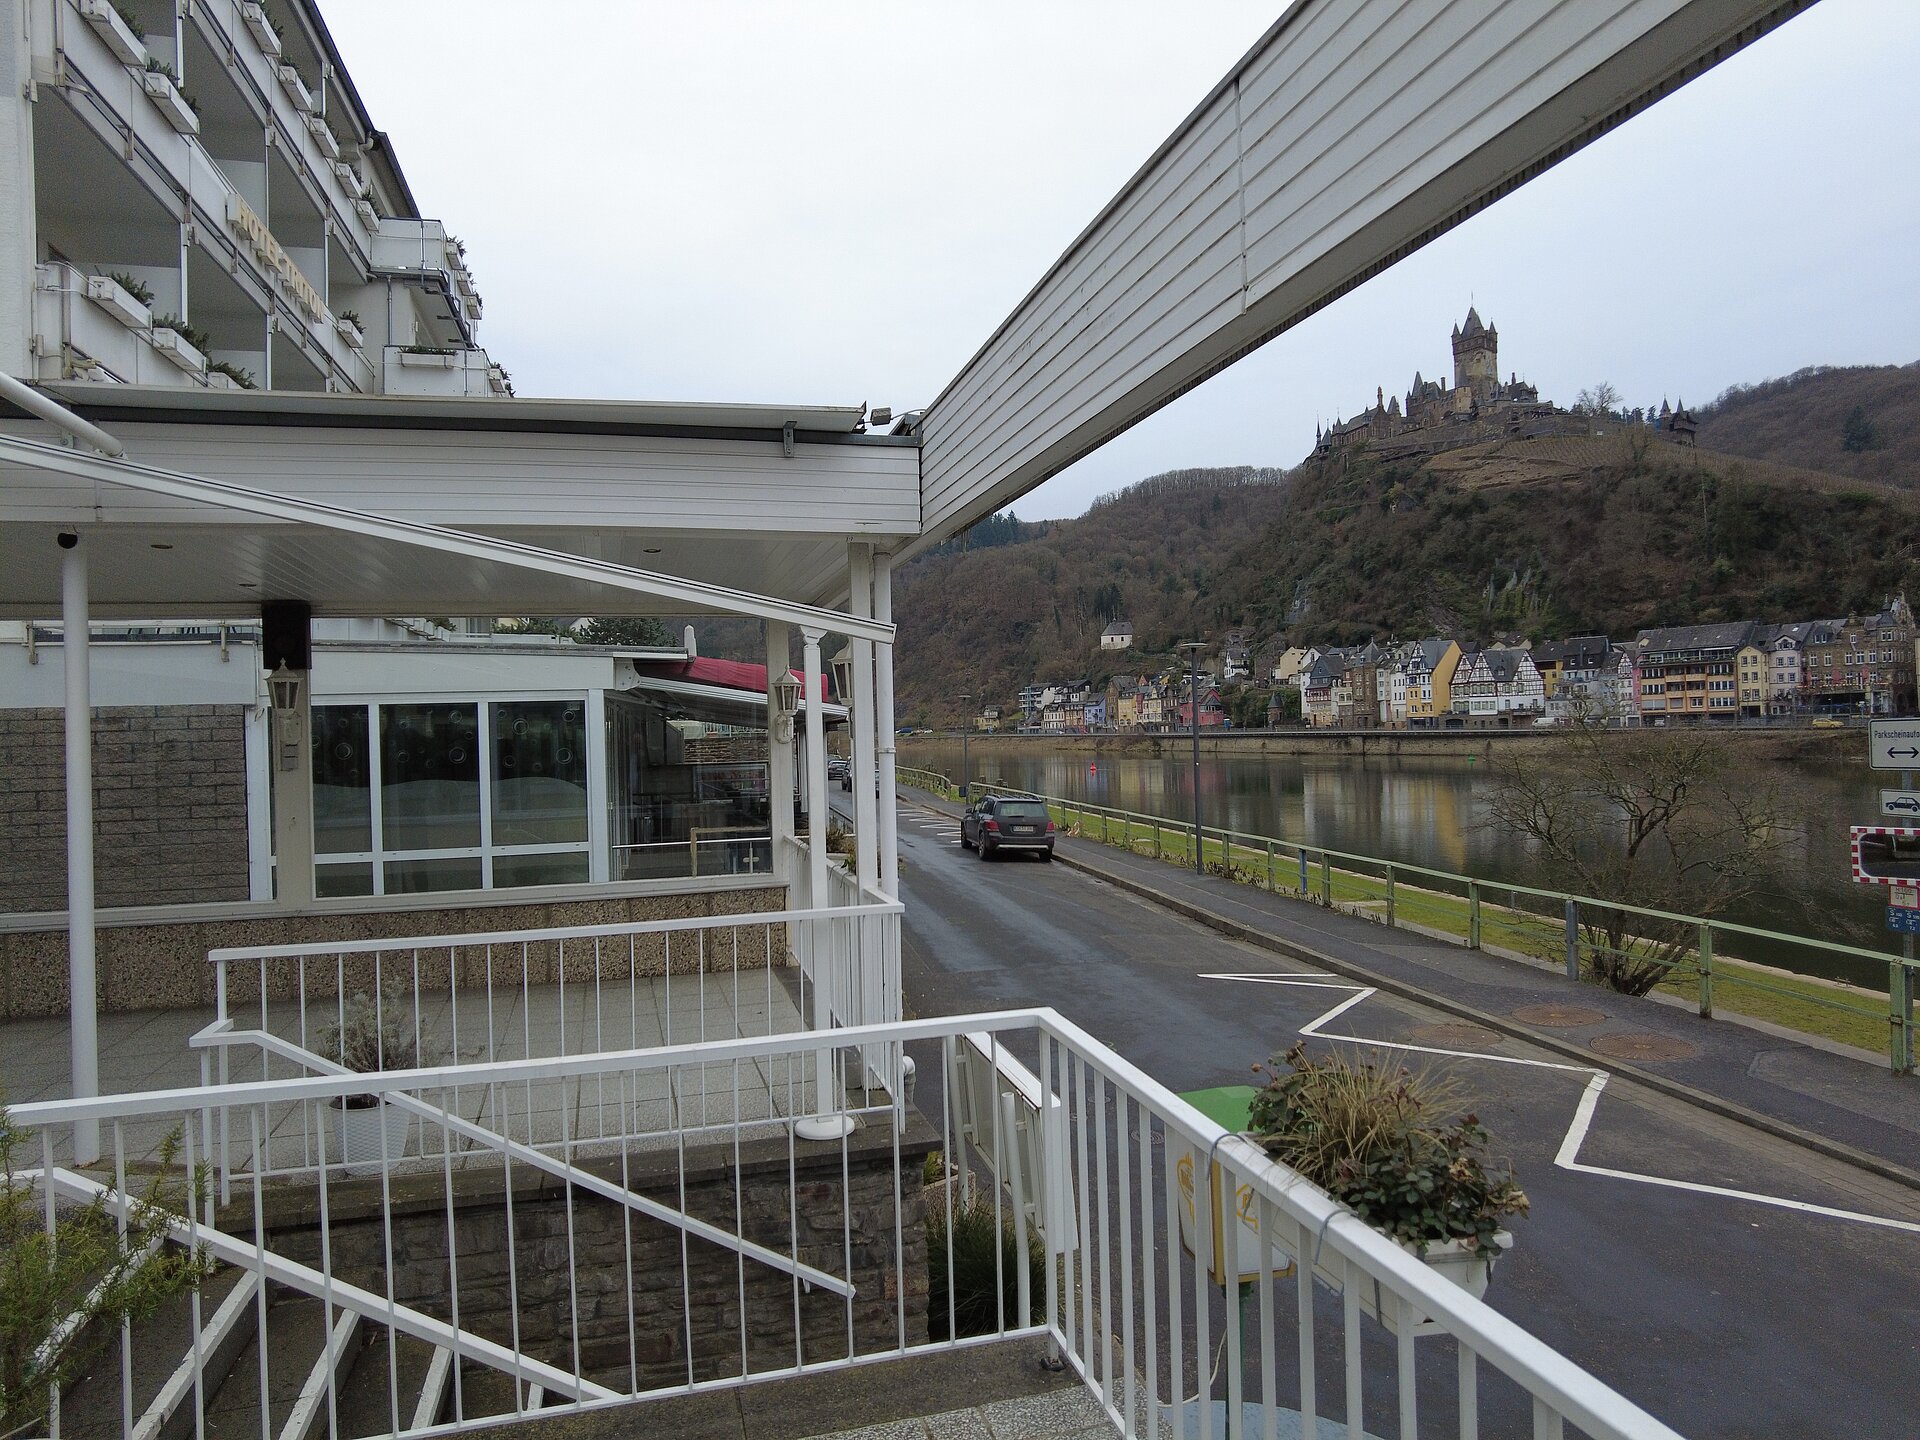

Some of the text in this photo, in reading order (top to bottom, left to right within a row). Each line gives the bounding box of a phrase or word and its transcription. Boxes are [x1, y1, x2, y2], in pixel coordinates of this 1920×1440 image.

[227, 193, 325, 324] HOTEL TRITON
[1873, 730, 1920, 739] Parkscheinauto
